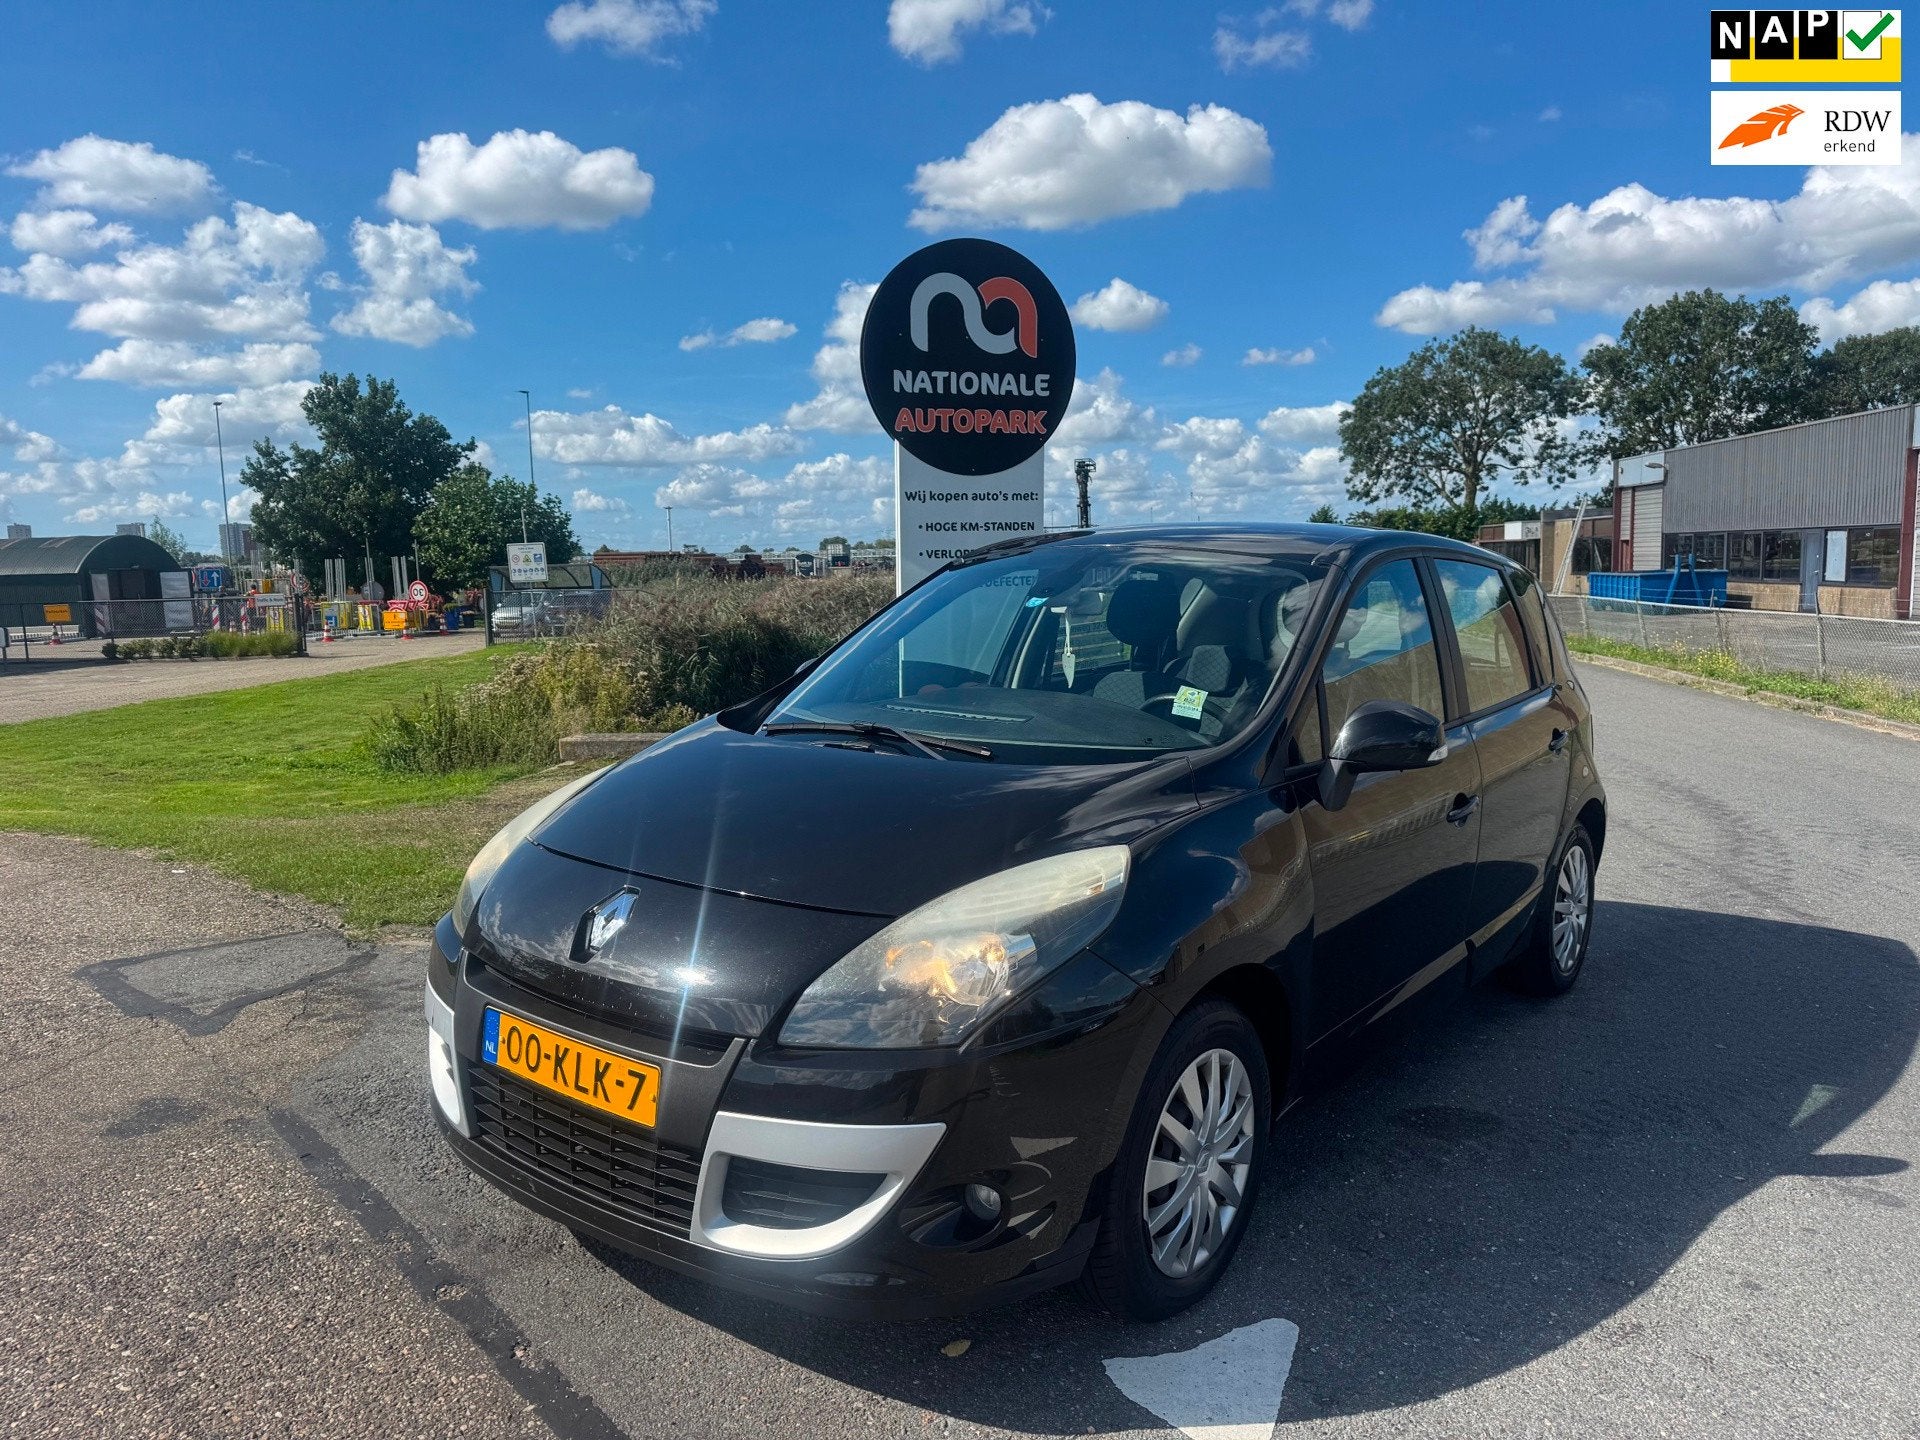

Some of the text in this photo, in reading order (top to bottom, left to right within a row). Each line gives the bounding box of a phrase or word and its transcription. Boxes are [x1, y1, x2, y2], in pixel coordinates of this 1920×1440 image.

[893, 369, 1050, 397] NATIONALE
[894, 407, 1047, 434] AUTOPARK
[904, 491, 1039, 503] Wij kopen auto's met:
[925, 521, 1035, 532] HOGE KM-STANDEN
[926, 549, 974, 559] VERLOP
[485, 1041, 496, 1055] NL
[506, 1025, 647, 1111] 00-KLK-7
